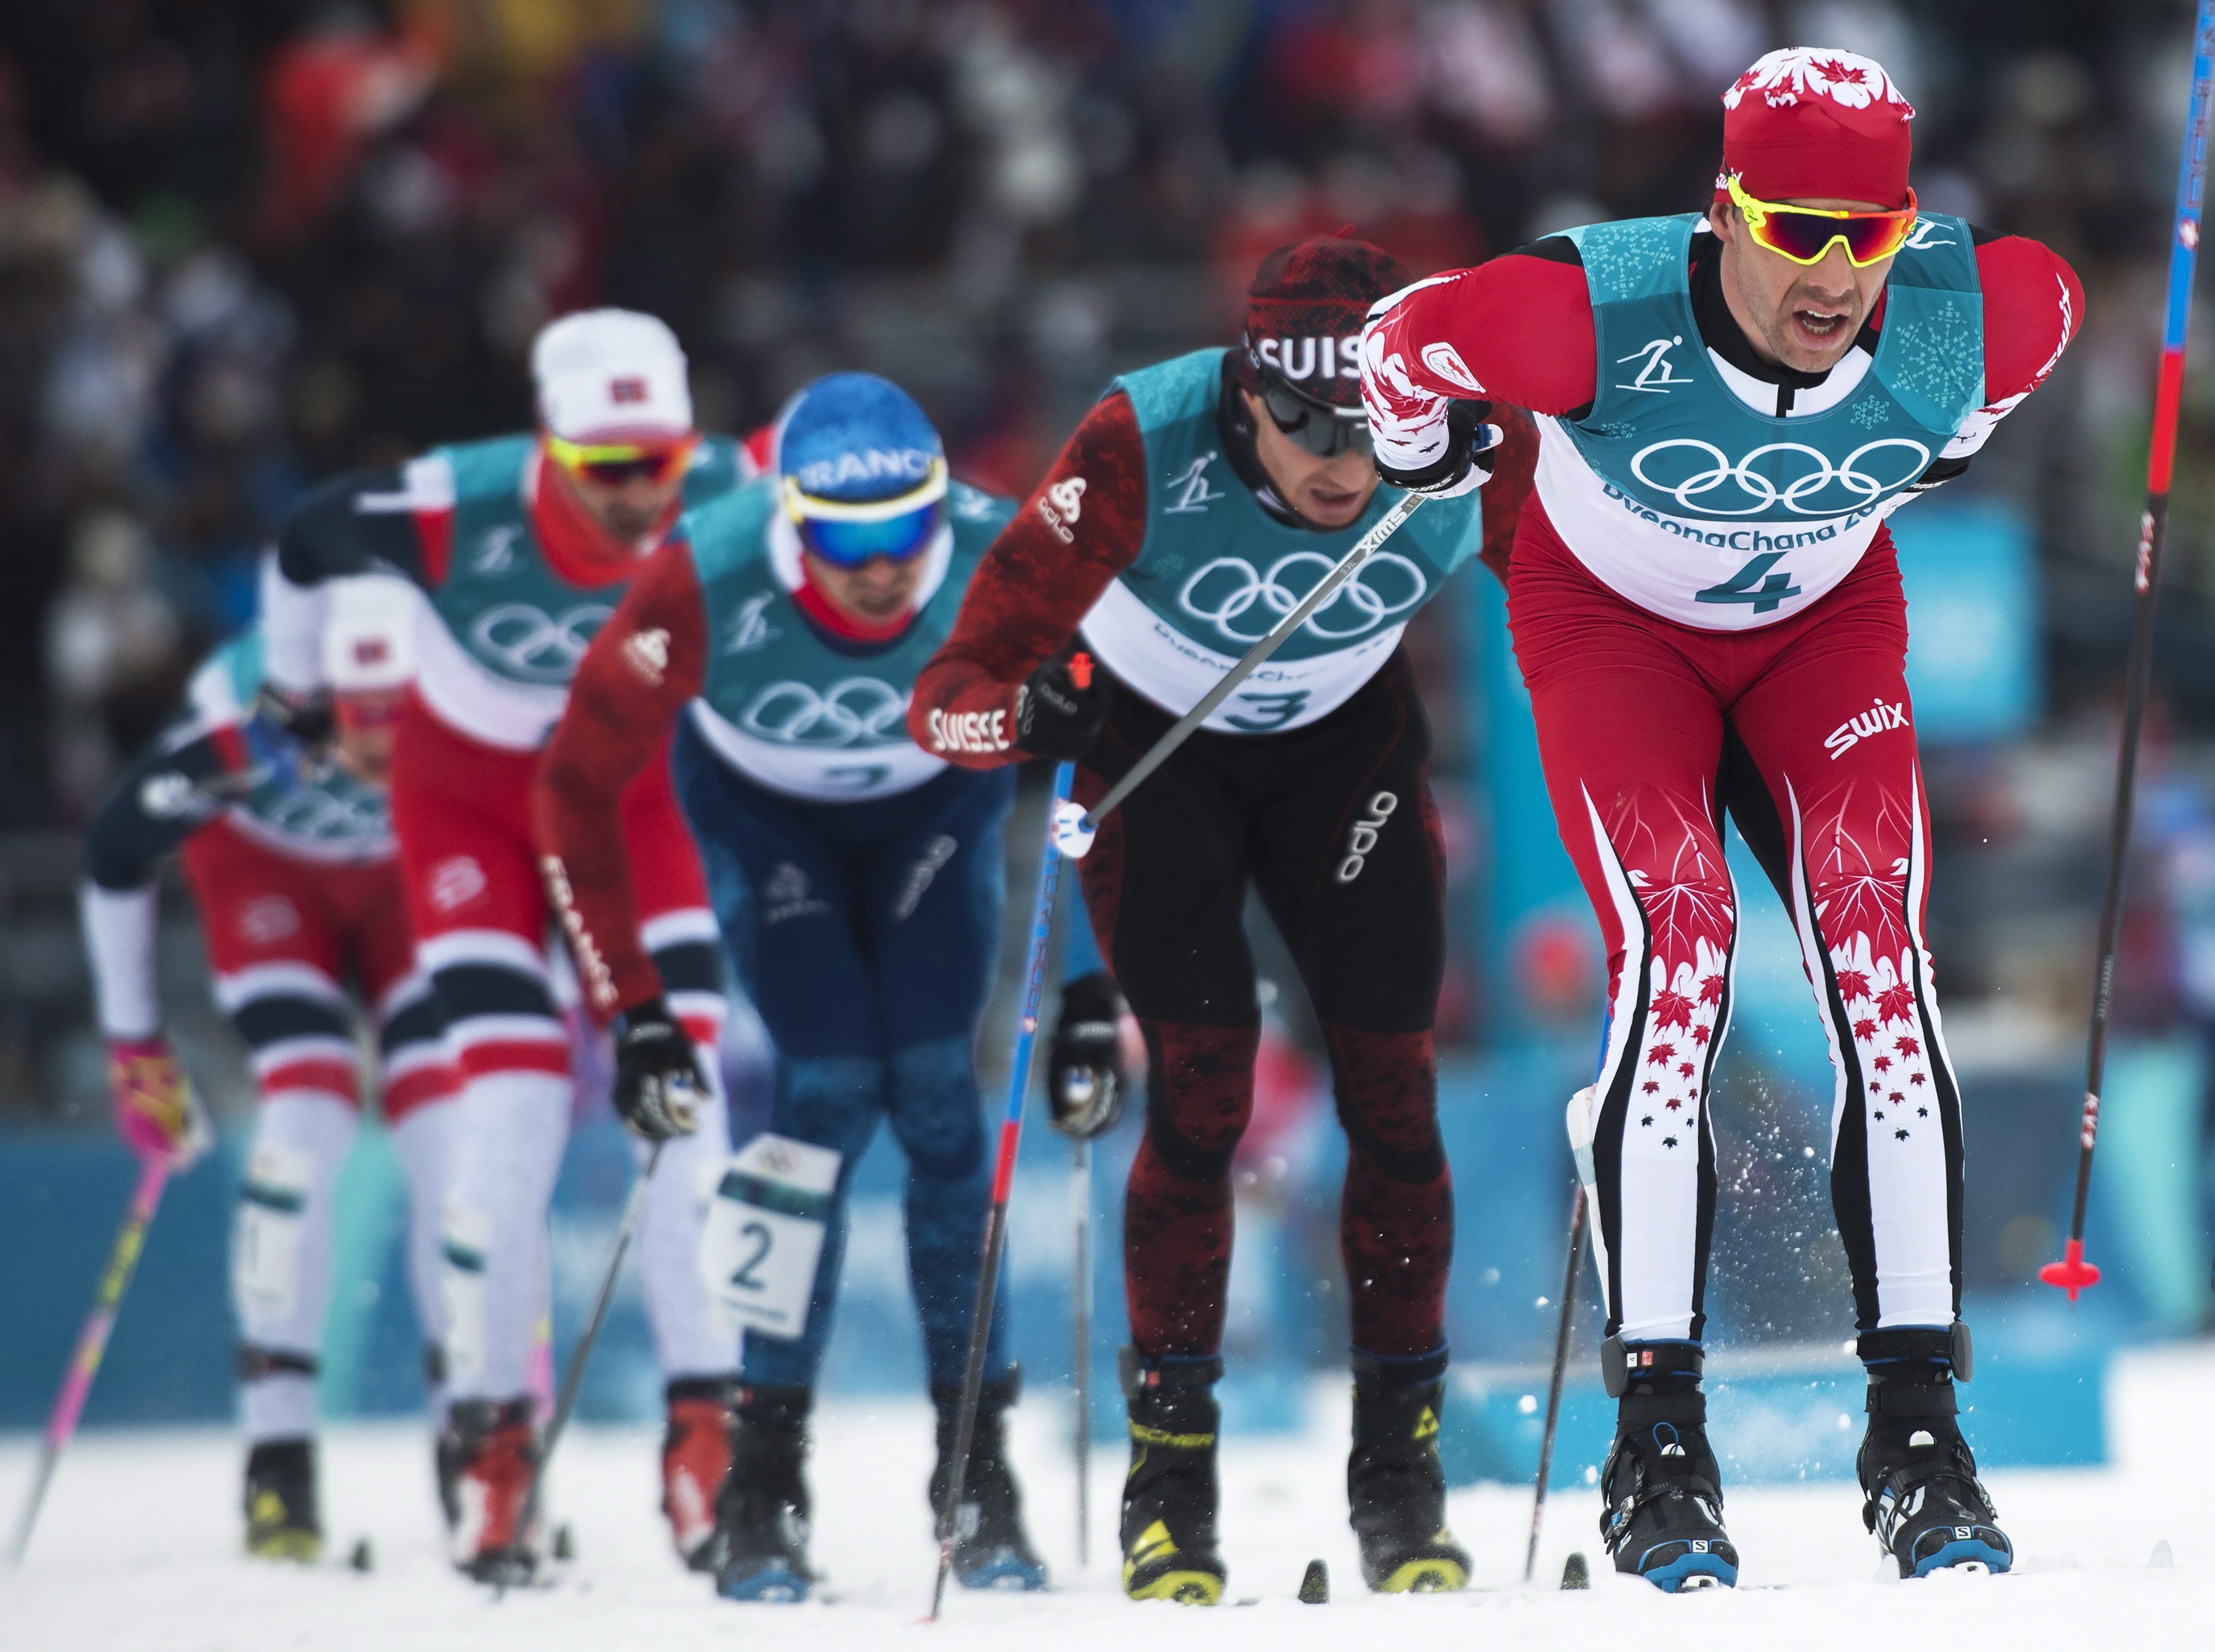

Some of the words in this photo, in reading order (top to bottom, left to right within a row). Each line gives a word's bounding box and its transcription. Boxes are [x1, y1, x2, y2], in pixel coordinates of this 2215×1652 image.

[1694, 551, 1802, 614] 4
[929, 708, 1010, 752] SUISSE
[1224, 688, 1312, 732] 3
[1823, 698, 1910, 760] swix
[1338, 791, 1398, 882] odlo
[730, 1221, 774, 1290] 2
